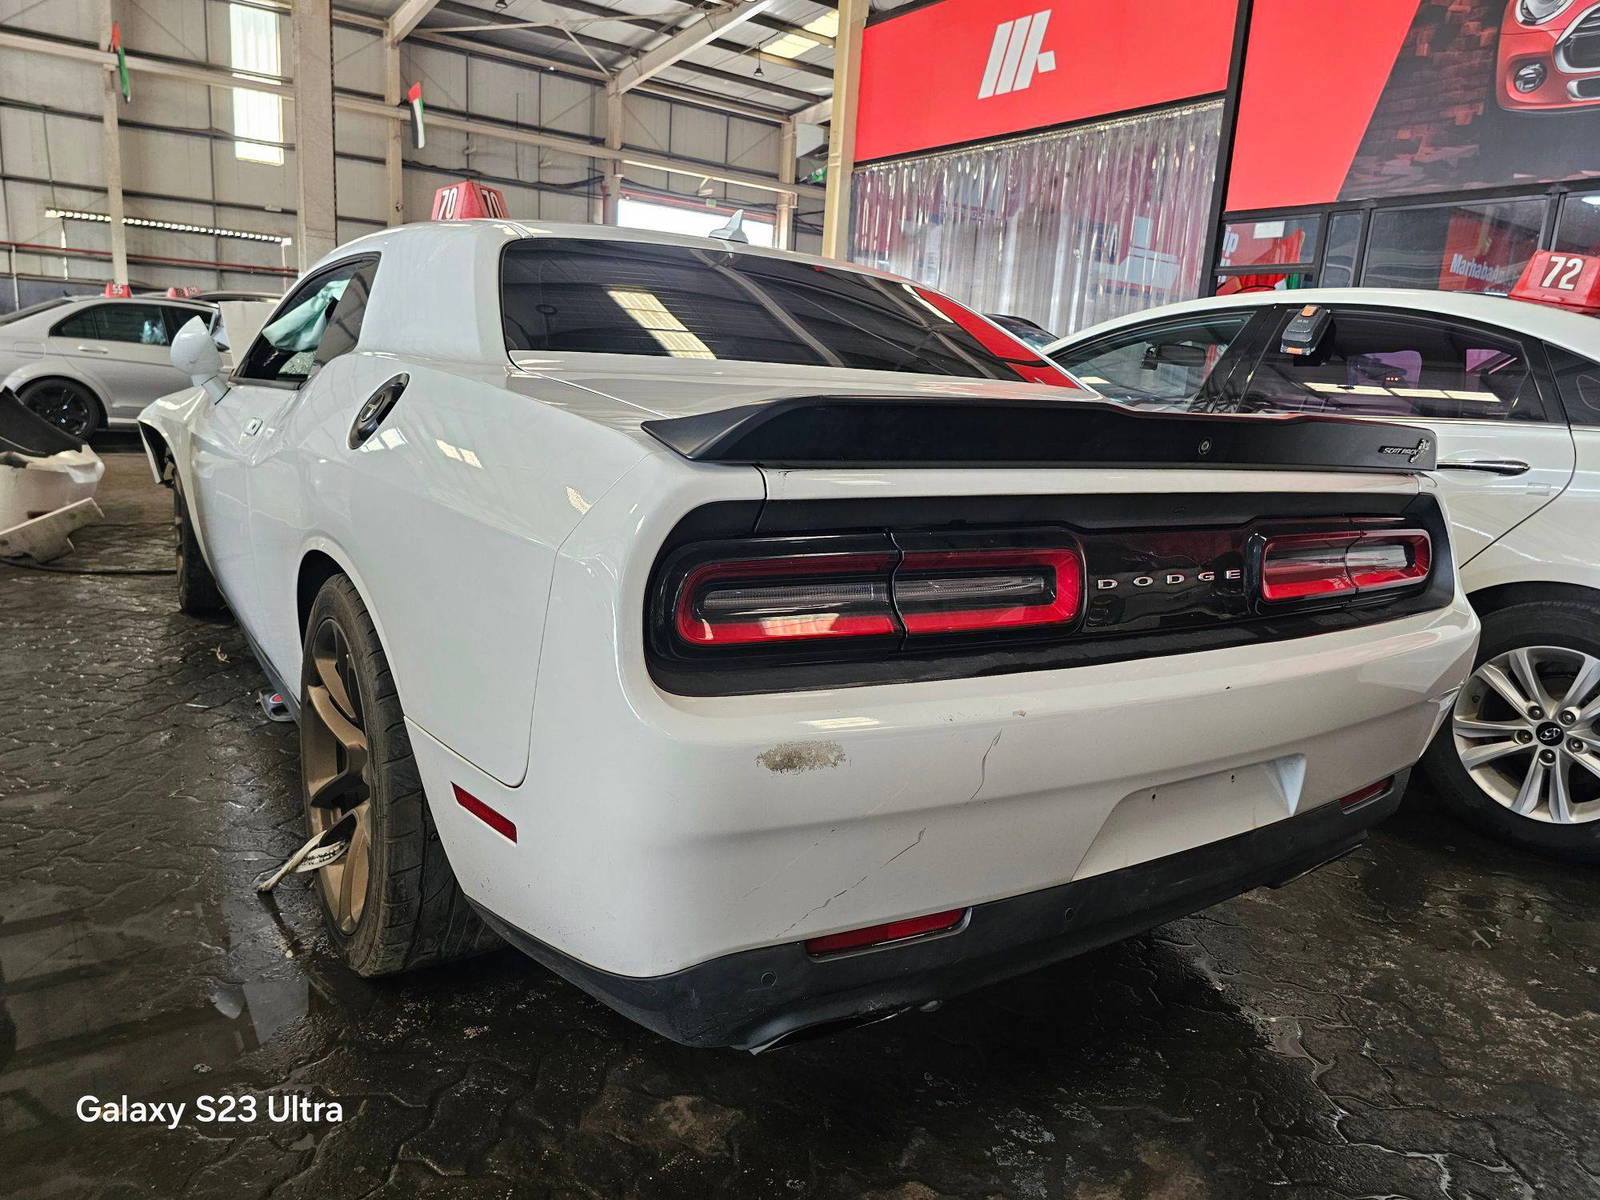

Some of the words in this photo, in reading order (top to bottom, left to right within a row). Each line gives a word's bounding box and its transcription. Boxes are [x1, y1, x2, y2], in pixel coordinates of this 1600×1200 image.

[438, 187, 458, 220] 70
[1541, 255, 1584, 290] 72
[1097, 569, 1241, 590] DODGE
